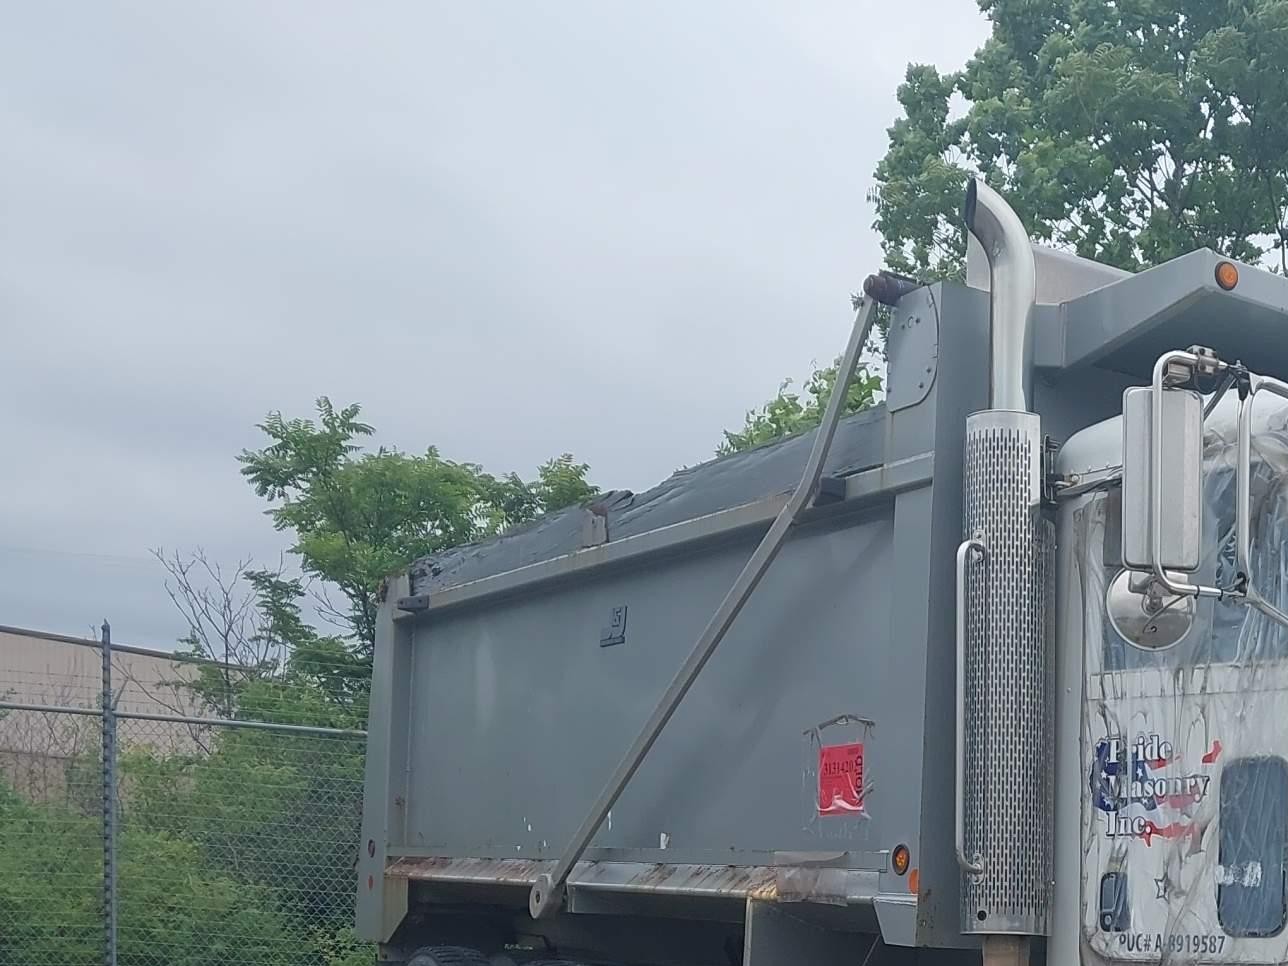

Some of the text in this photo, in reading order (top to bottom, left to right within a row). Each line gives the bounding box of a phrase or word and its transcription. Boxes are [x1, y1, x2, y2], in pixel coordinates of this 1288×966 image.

[1106, 735, 1173, 764] Pride
[1107, 774, 1210, 803] Masonry
[1106, 811, 1153, 837] Inc.
